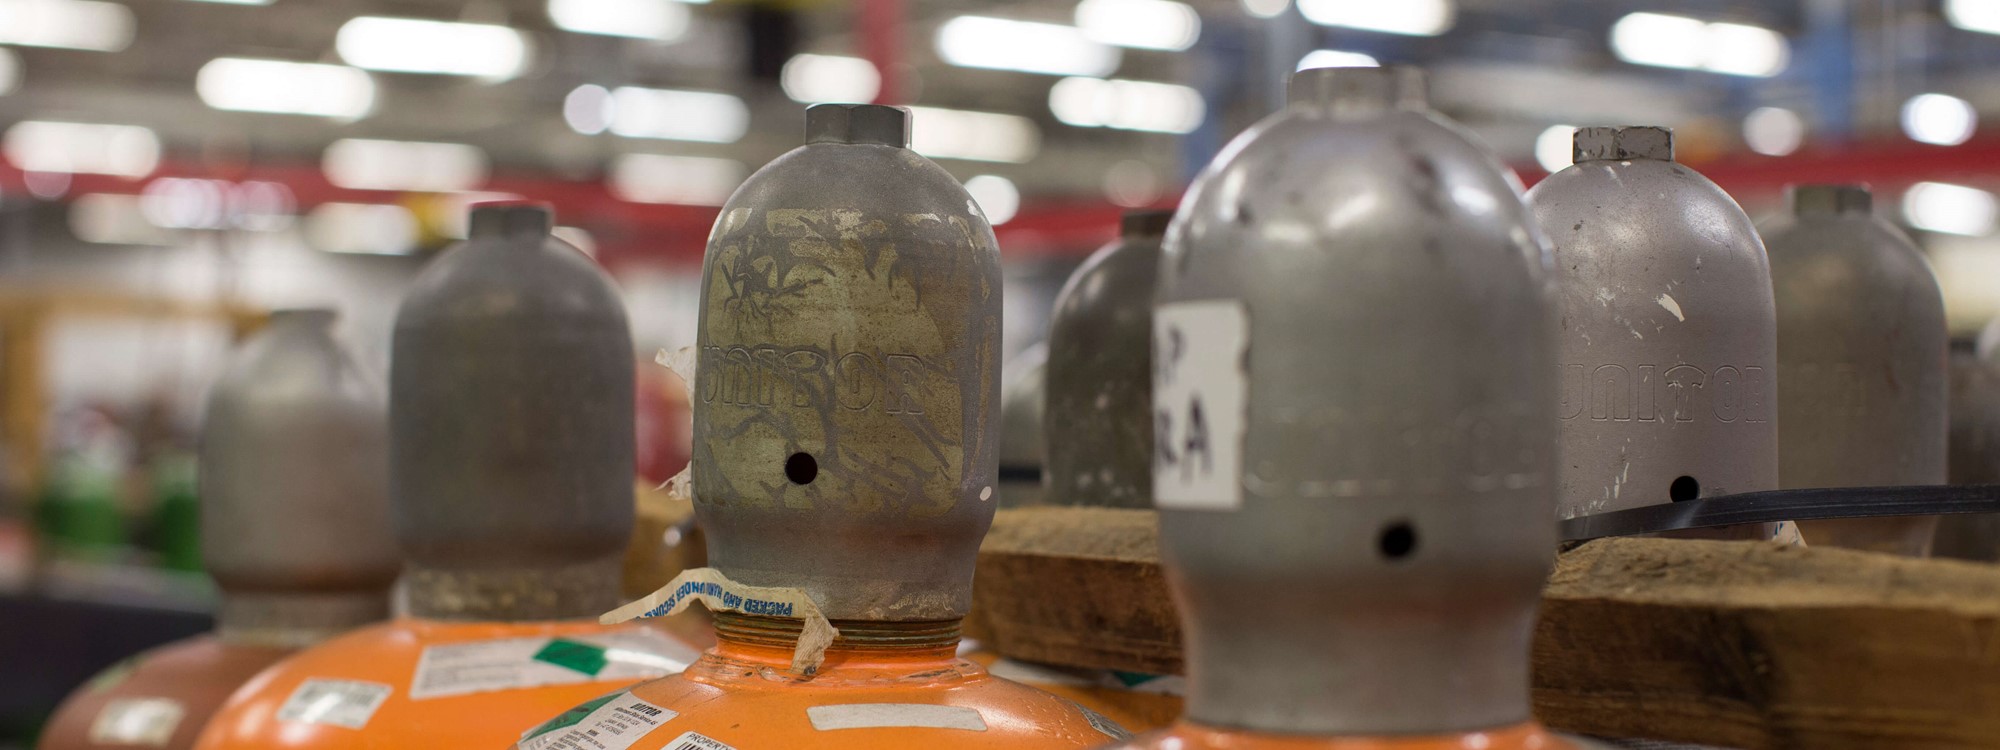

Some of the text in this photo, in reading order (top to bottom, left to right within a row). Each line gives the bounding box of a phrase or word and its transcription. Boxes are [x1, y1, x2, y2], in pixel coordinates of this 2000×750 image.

[701, 346, 925, 415] UNITOR
[1557, 363, 1767, 424] UNITOR
[676, 581, 705, 602] UNDER
[723, 592, 743, 609] AND
[743, 598, 793, 616] PACKED
